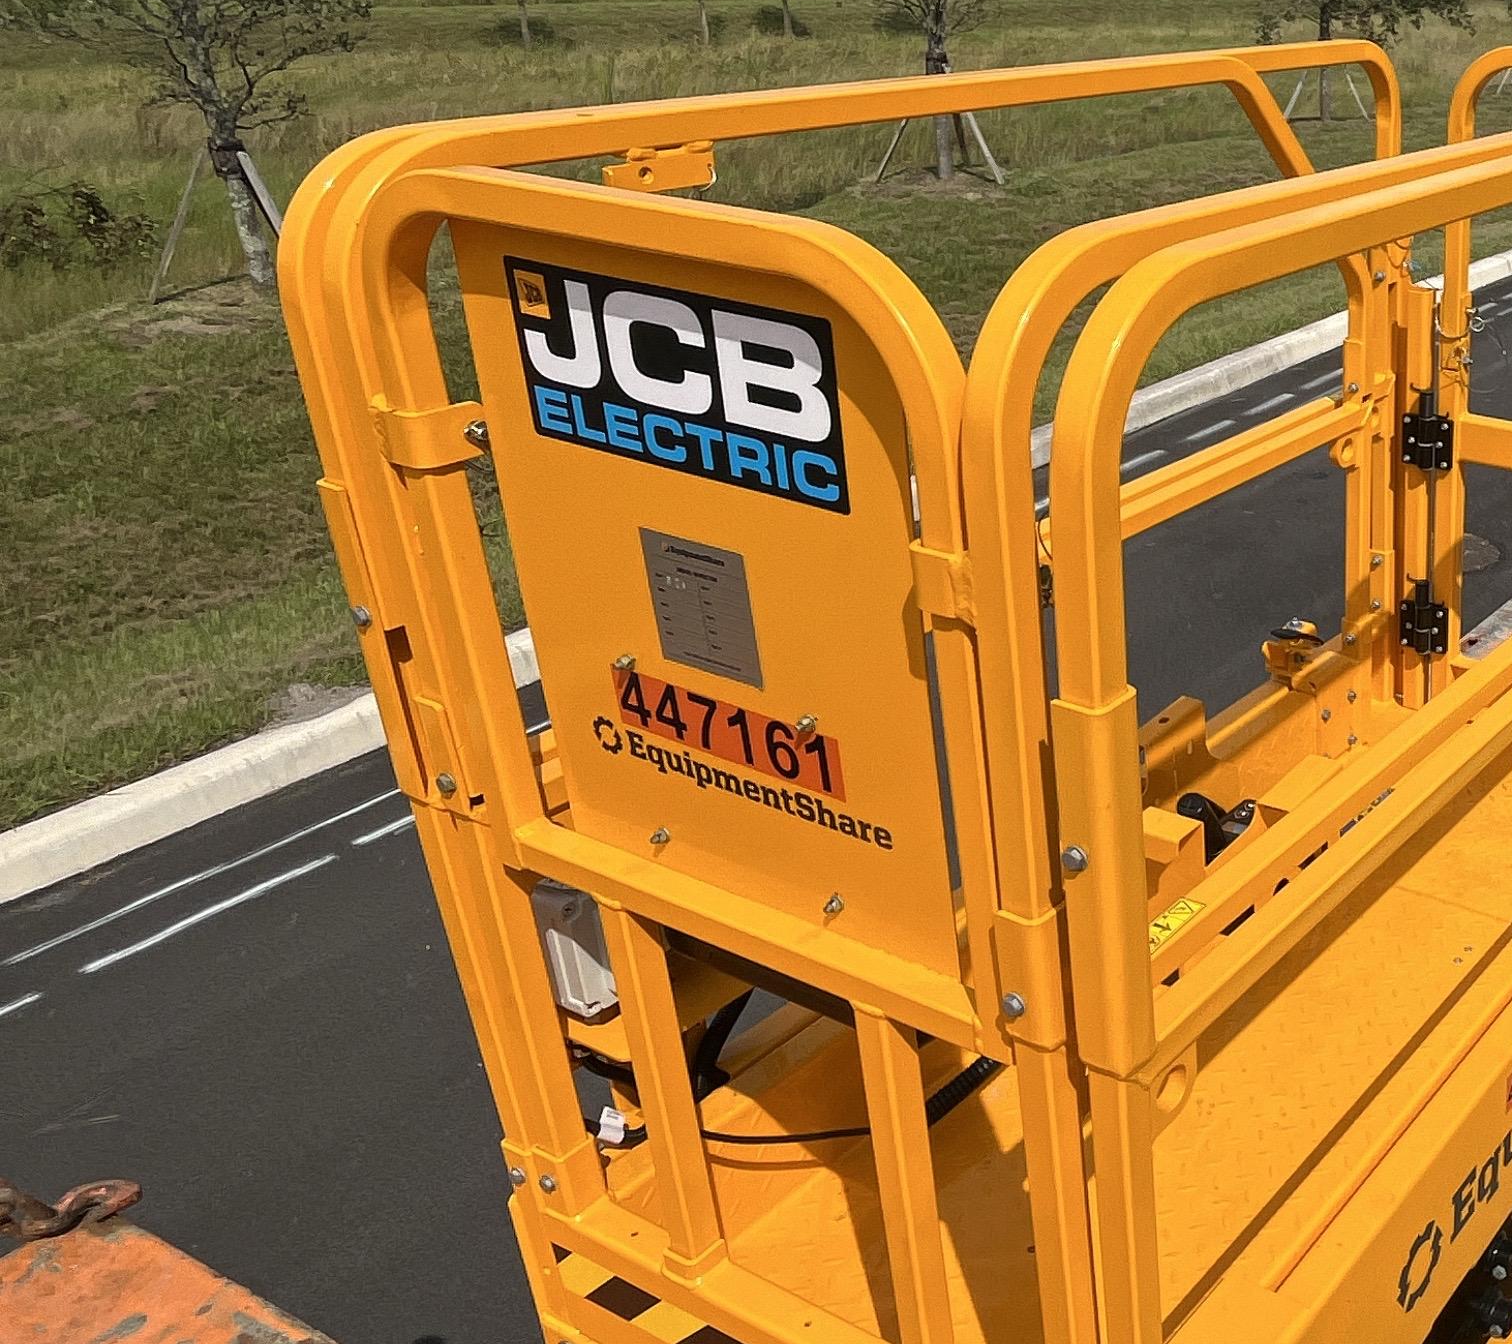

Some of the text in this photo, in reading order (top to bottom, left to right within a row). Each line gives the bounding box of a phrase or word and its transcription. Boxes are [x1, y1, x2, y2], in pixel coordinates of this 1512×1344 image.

[523, 279, 832, 442] JCB
[534, 386, 840, 502] ELECTRIC
[620, 671, 832, 793] 447161
[625, 729, 893, 850] EquipmentShare
